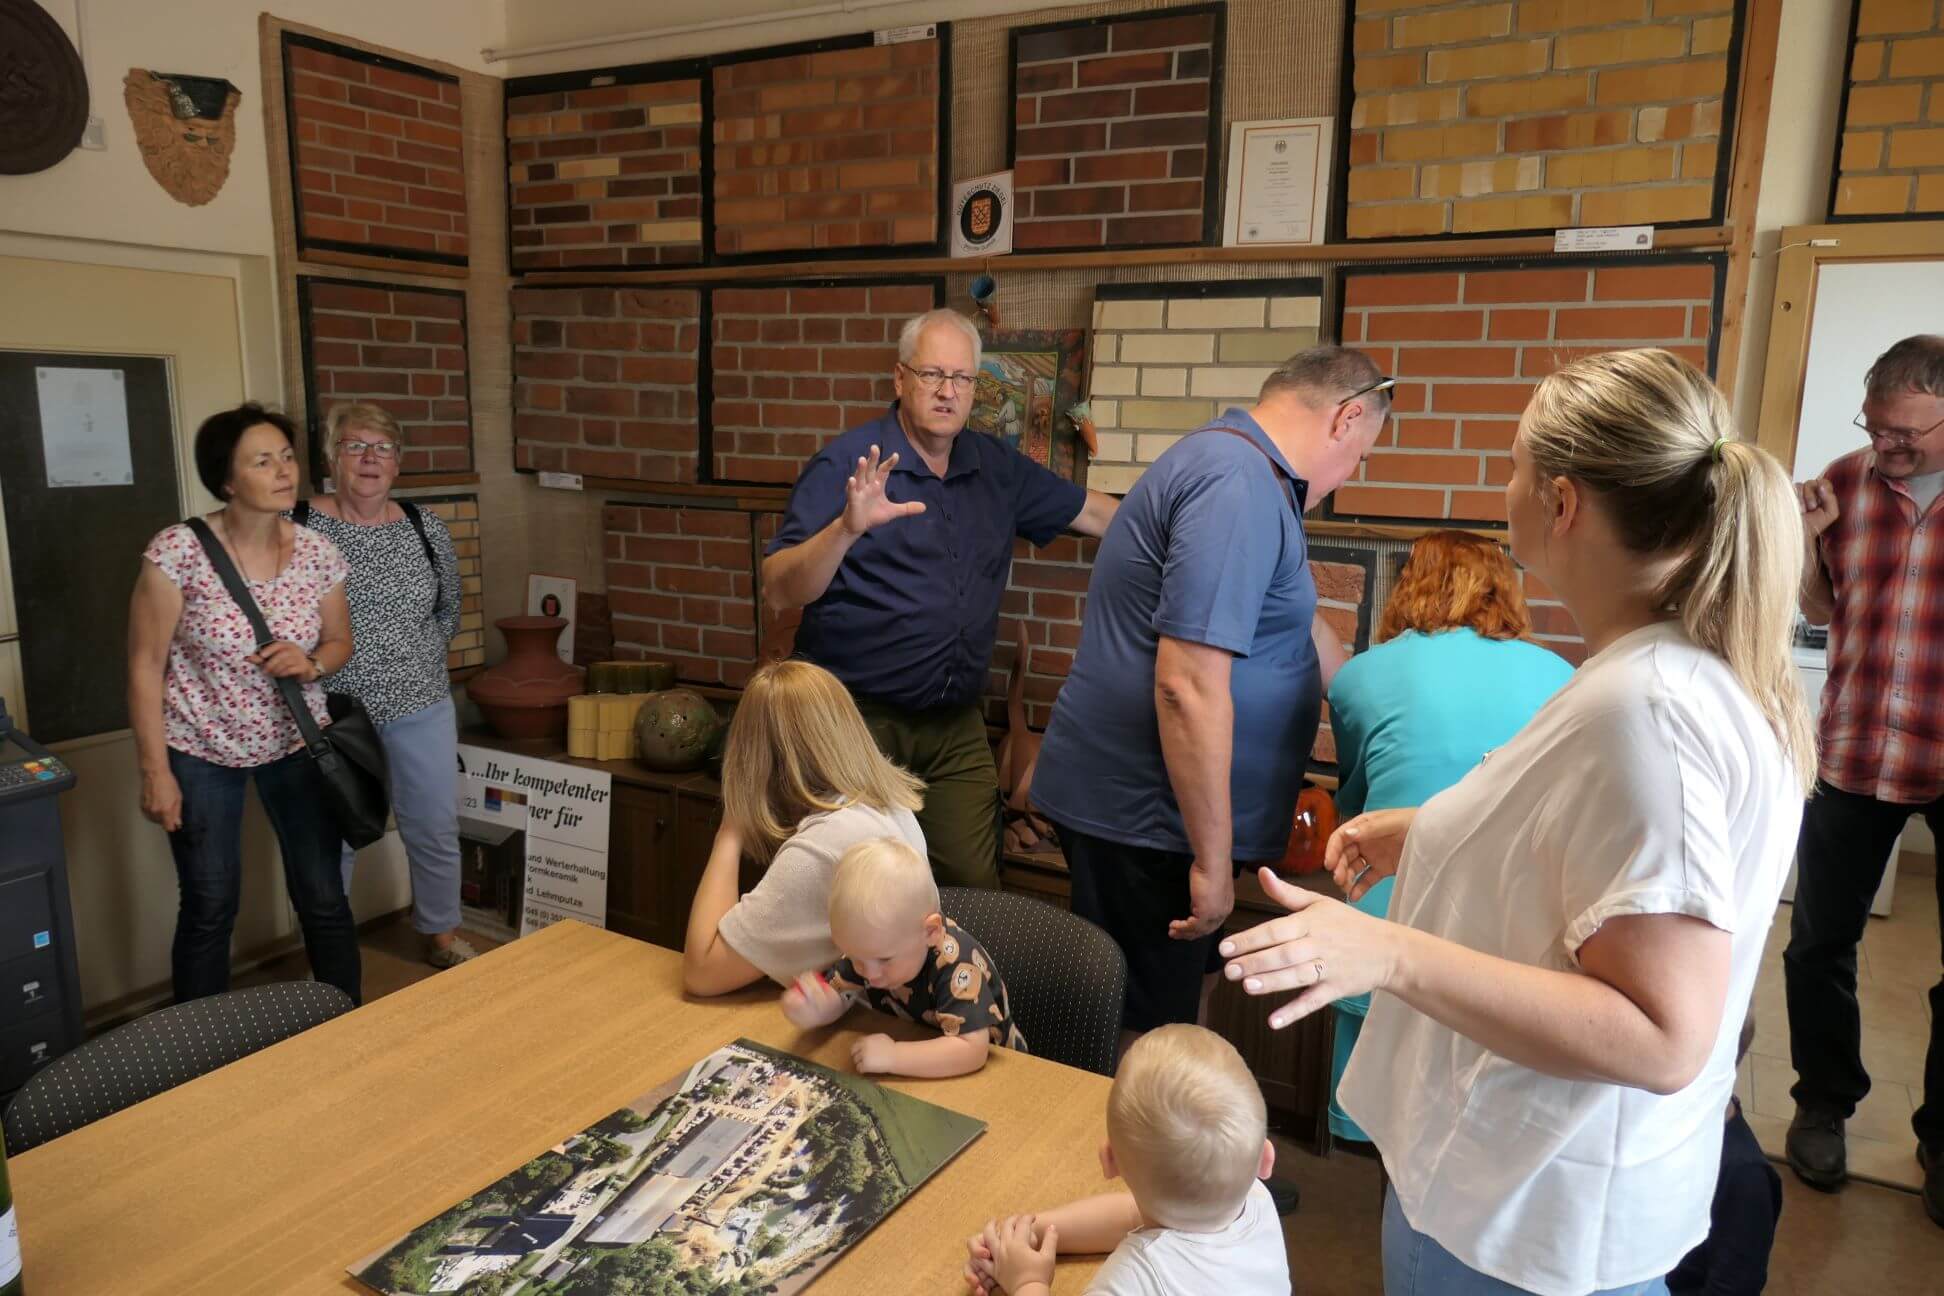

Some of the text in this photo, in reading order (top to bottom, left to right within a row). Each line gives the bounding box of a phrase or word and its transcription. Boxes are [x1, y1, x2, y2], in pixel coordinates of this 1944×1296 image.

[513, 768, 608, 801] kompetenter
[554, 806, 583, 829] für
[528, 865, 578, 883] ormkeramik
[545, 856, 606, 880] Werterhaltung
